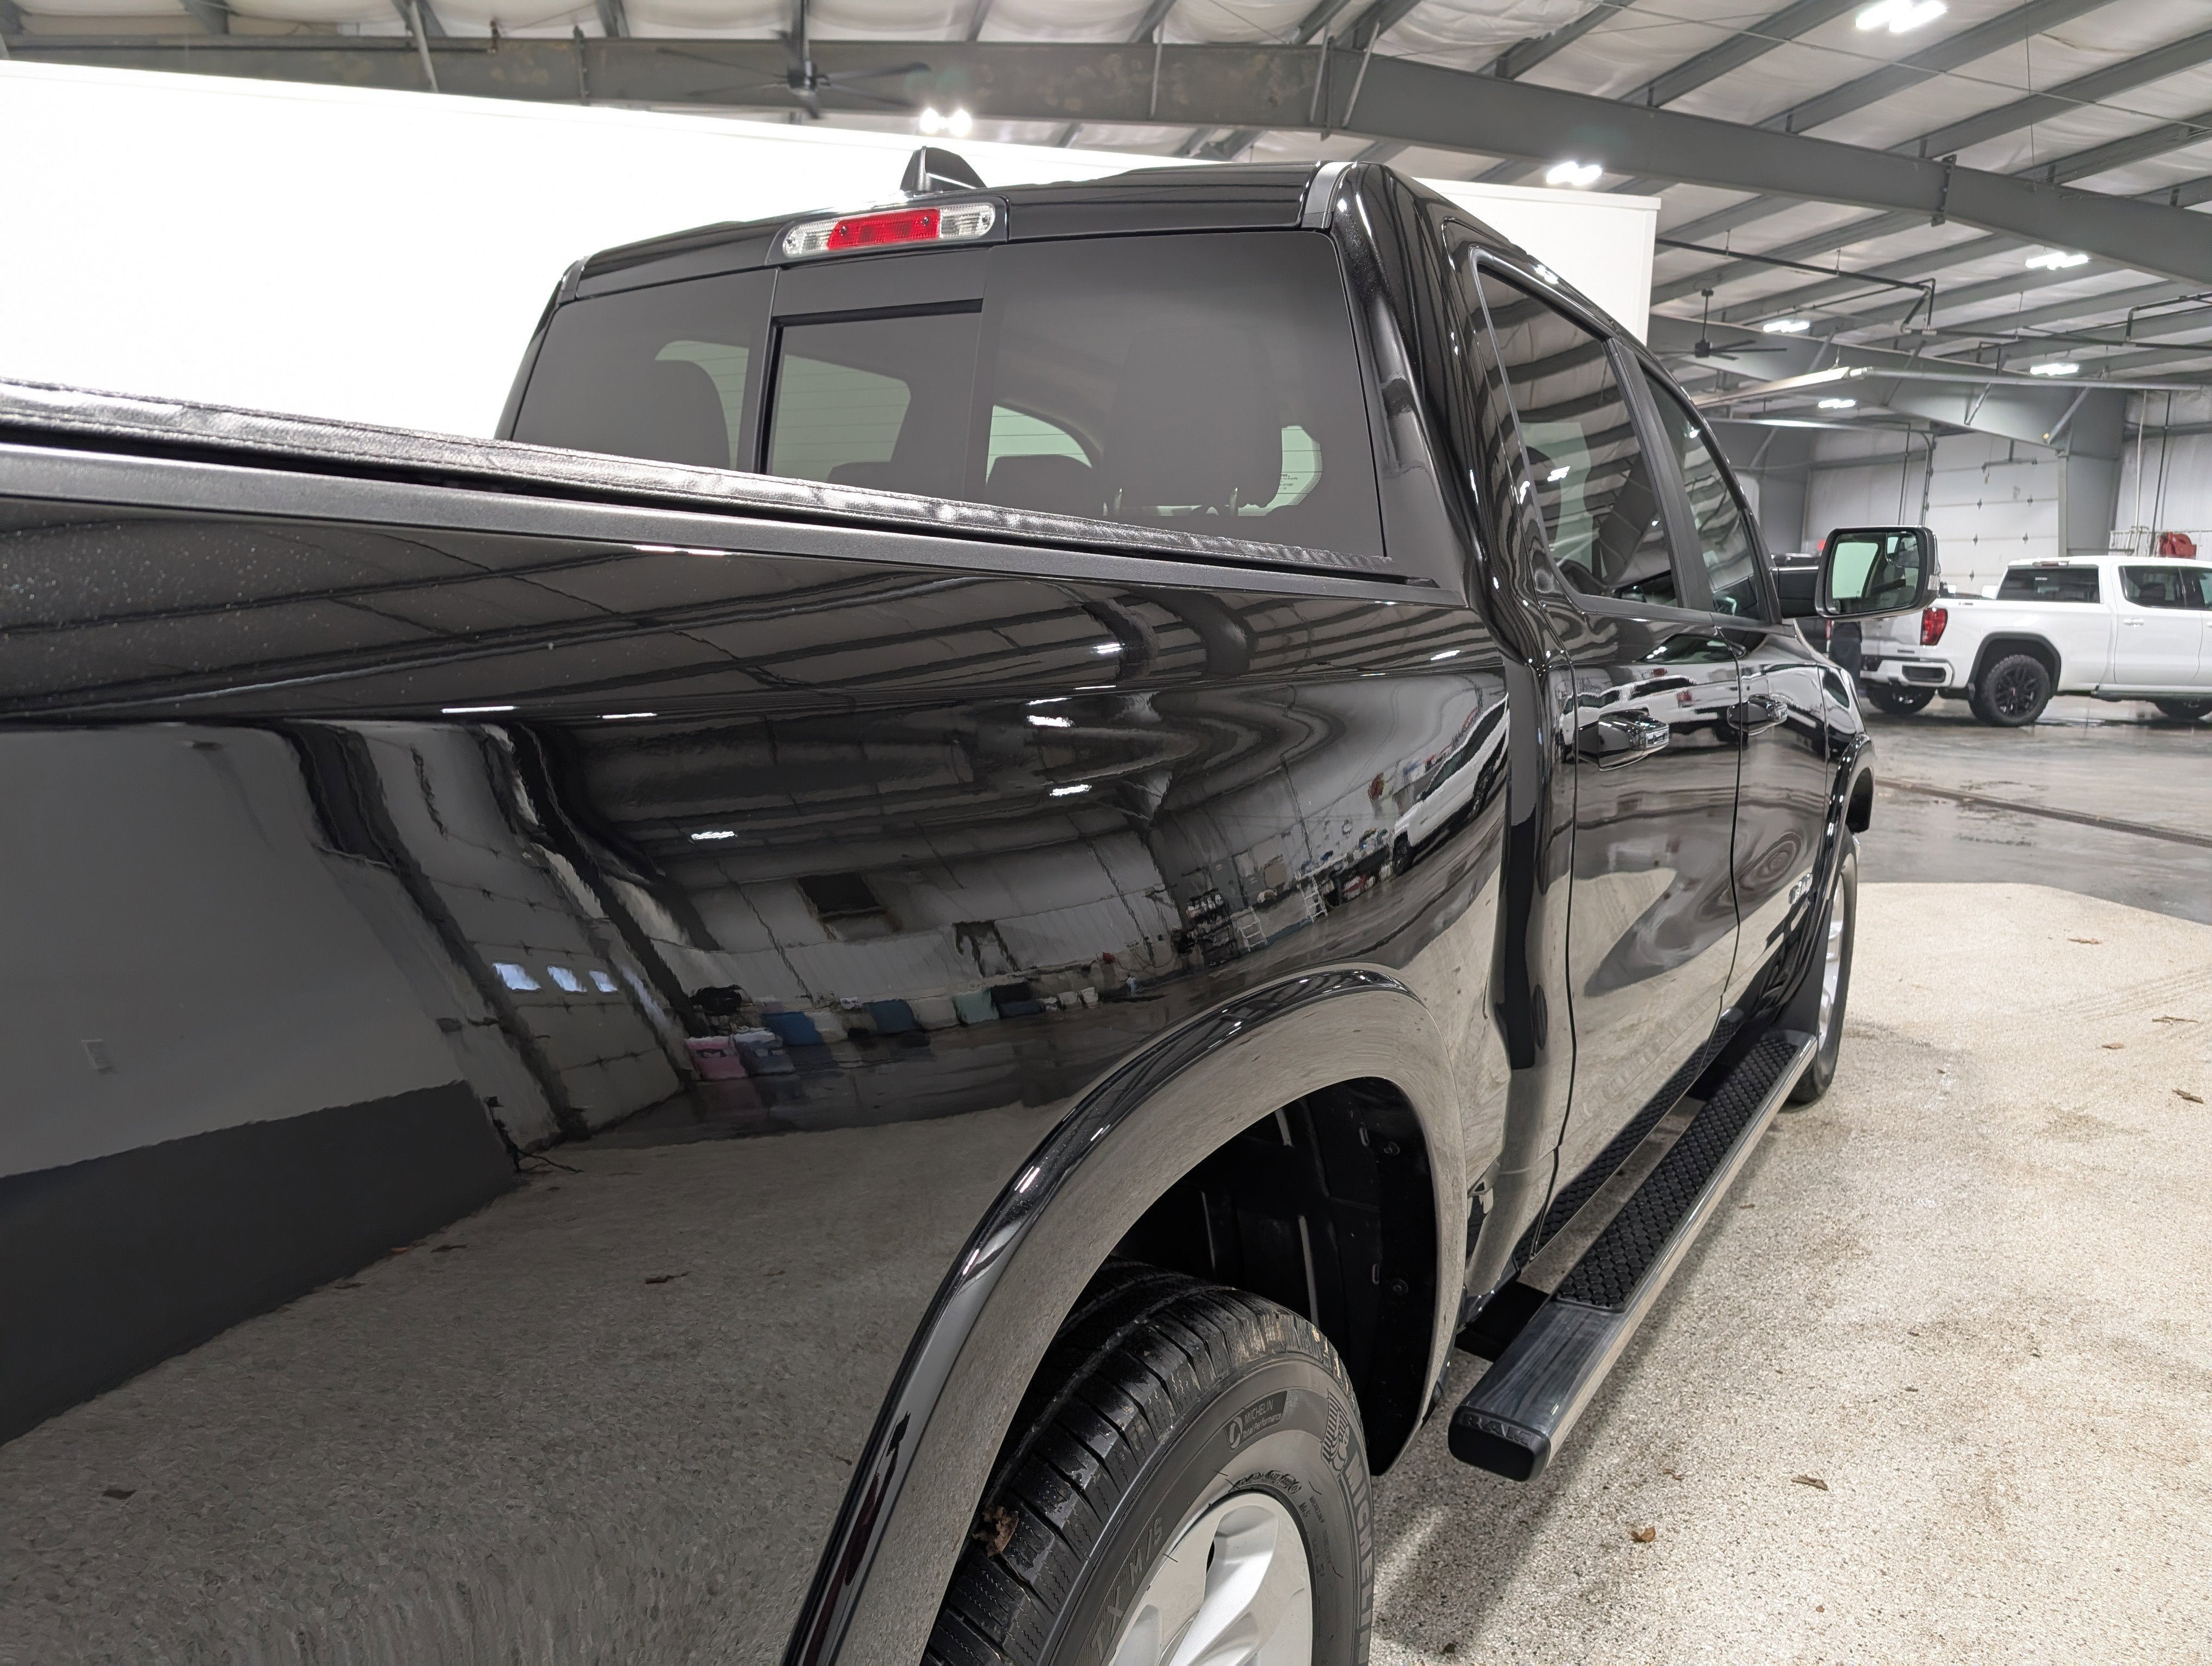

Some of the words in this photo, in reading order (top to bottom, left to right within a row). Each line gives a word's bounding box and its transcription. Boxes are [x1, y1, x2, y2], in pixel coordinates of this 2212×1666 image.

[1244, 1399, 1273, 1425] MICHELIN
[1461, 1412, 1531, 1445] RAM
[1130, 1517, 1162, 1587] M/S
[1346, 1451, 1373, 1664] MICHELIN
